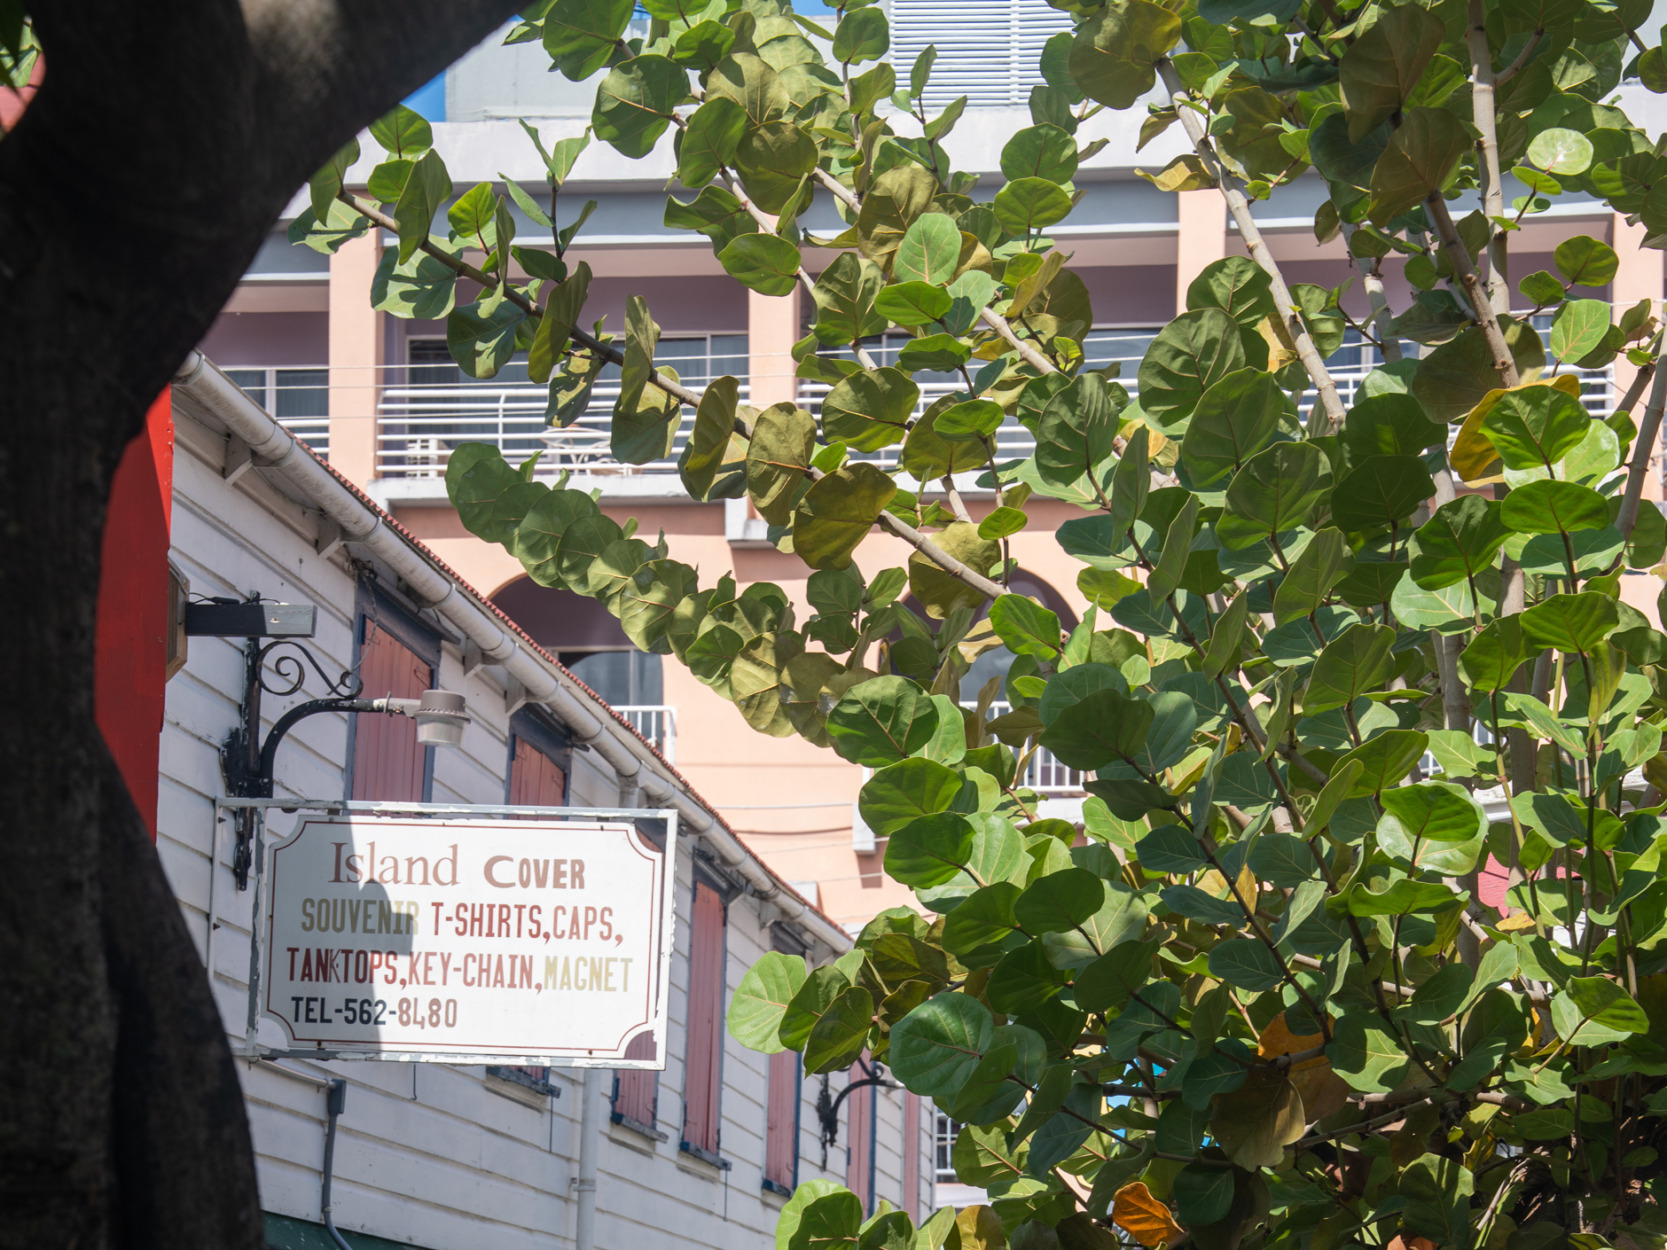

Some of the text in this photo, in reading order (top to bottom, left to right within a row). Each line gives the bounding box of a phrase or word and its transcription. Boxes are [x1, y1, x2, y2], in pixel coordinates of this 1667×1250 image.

[328, 841, 585, 889] Island COVER
[301, 897, 420, 935] SOUVENIR
